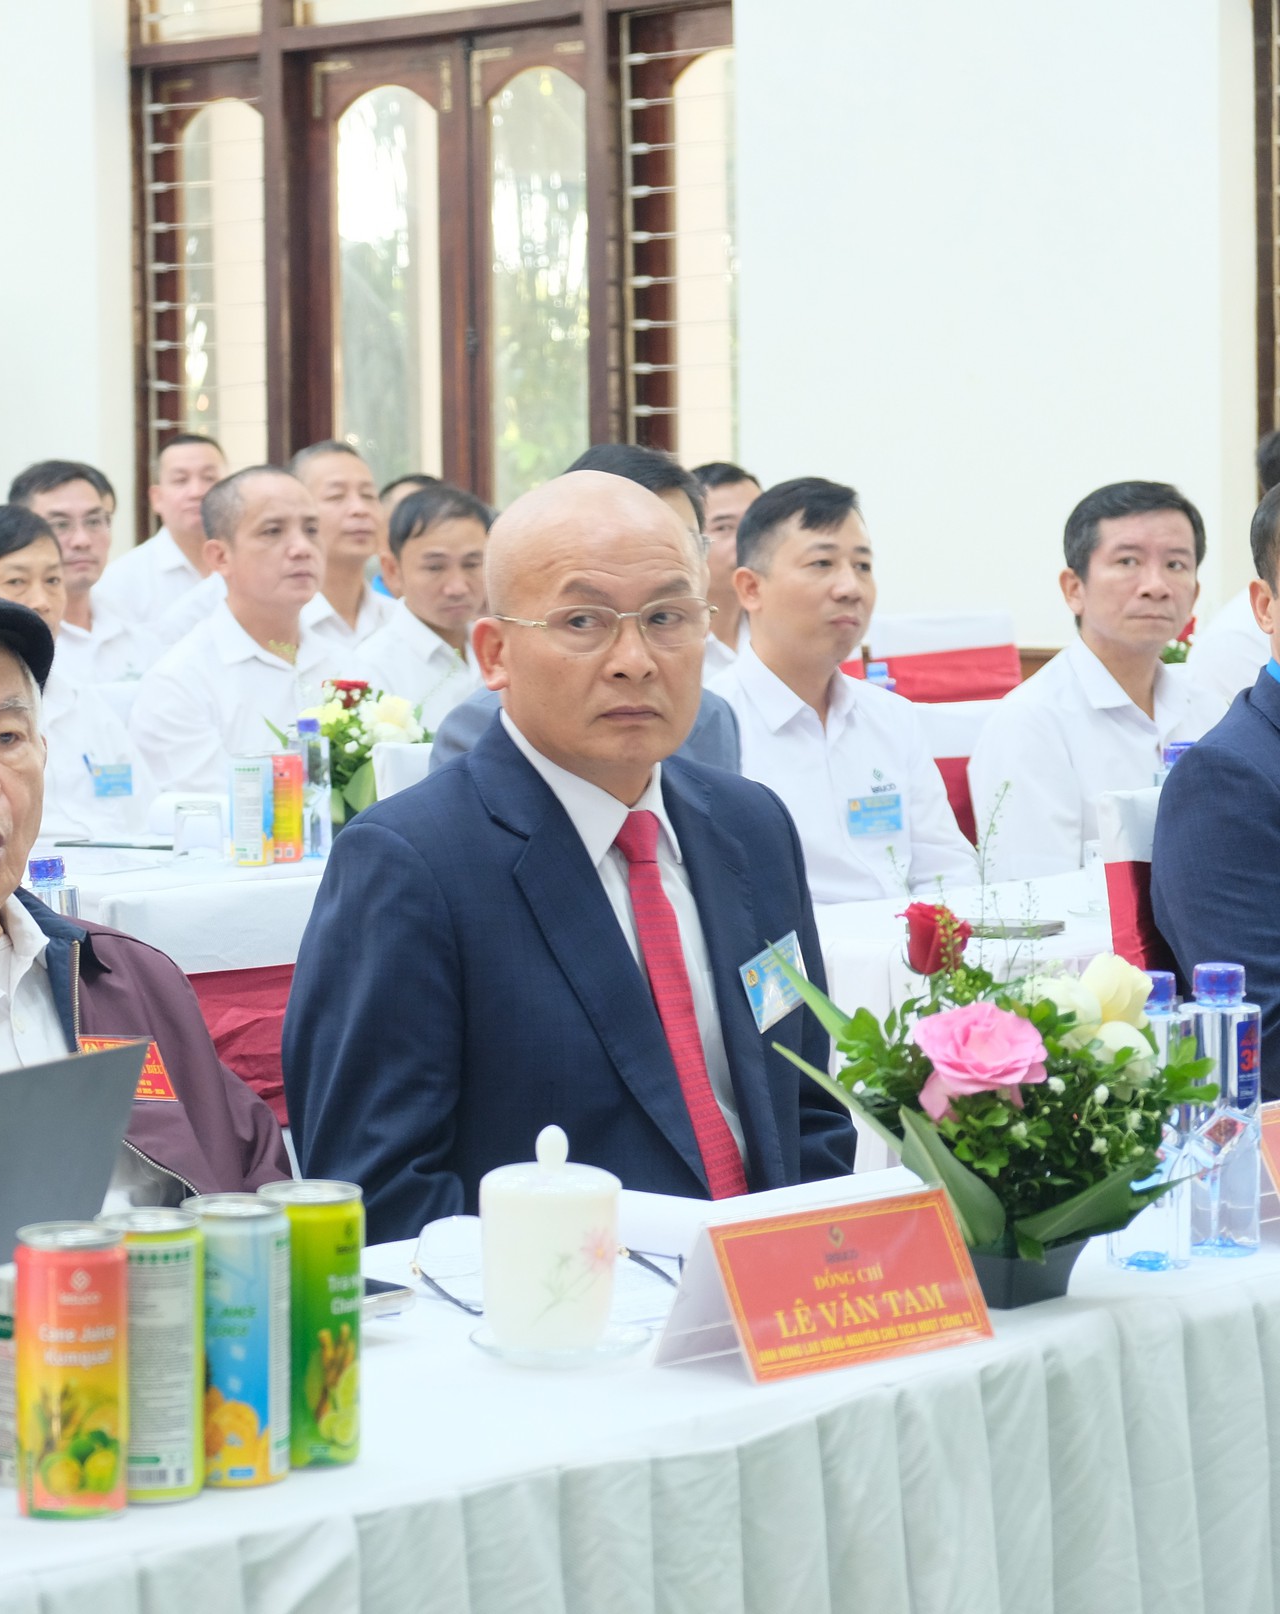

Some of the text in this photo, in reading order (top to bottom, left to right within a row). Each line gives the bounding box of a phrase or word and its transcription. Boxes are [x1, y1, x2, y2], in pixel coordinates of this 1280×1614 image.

[775, 1283, 947, 1338] LÊ VĂN TAM
